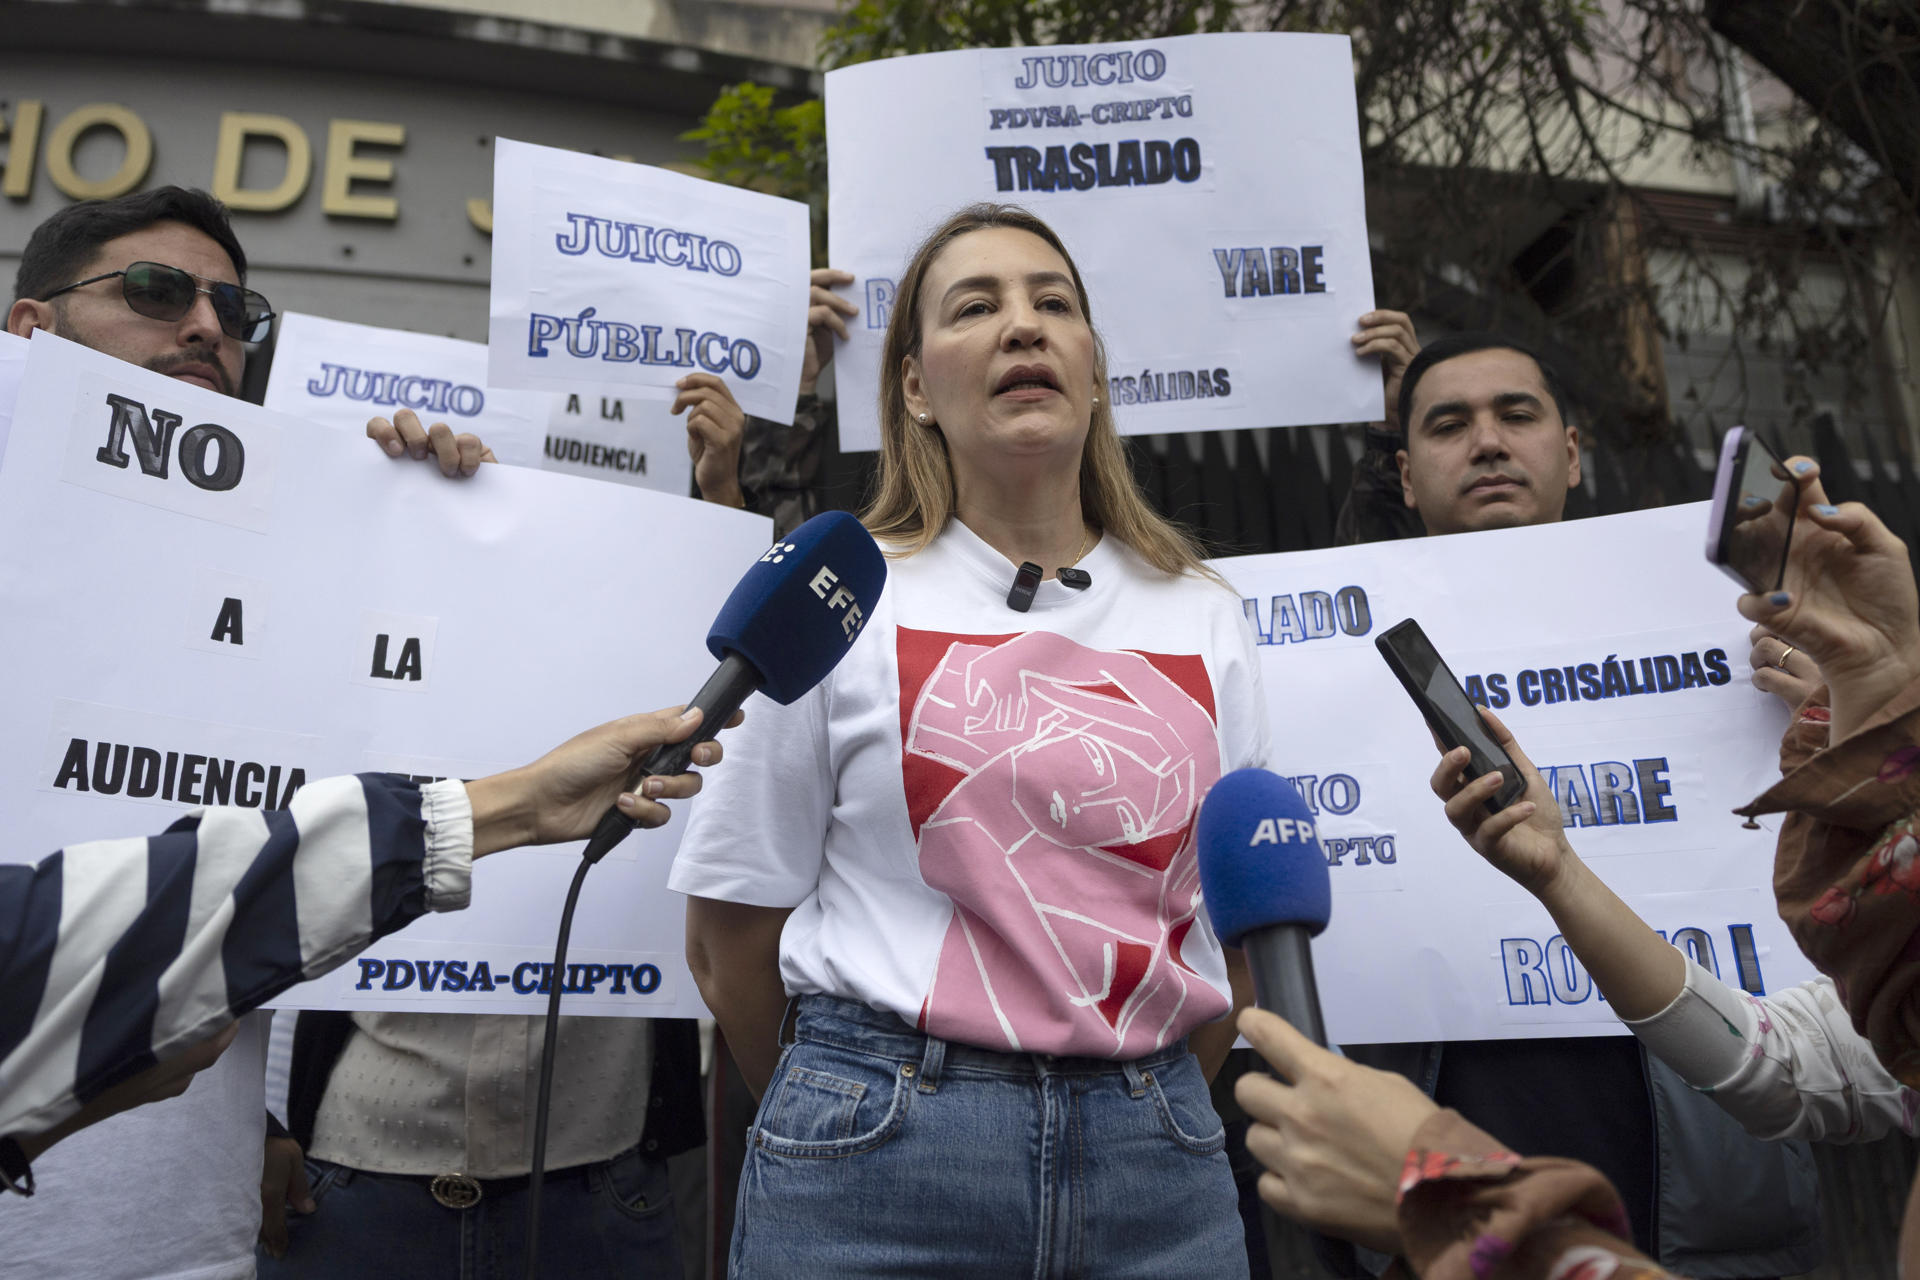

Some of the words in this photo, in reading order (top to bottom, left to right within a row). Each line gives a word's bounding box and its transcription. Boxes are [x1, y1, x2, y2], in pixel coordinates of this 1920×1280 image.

[1015, 49, 1167, 89] JUICIO
[990, 95, 1193, 130] PDVSA-CRIPTO
[0, 100, 152, 201] IO
[211, 111, 405, 219] DE
[985, 137, 1201, 192] TRASLADO
[556, 212, 742, 277] JUICIO
[1212, 245, 1326, 298] YARE
[528, 306, 761, 380] PÚBLICO
[307, 362, 485, 417] JUICIO
[566, 393, 581, 415] A
[601, 398, 624, 422] LA
[1110, 368, 1232, 406] ISÁLIDAS
[96, 393, 245, 491] NO
[210, 597, 243, 645] A
[370, 634, 422, 681] LA
[1242, 585, 1372, 646] LADO
[1465, 673, 1511, 709] AS
[1516, 648, 1732, 706] CRISÁLIDAS
[1249, 817, 1315, 847] AFP
[1323, 835, 1397, 866] PTO
